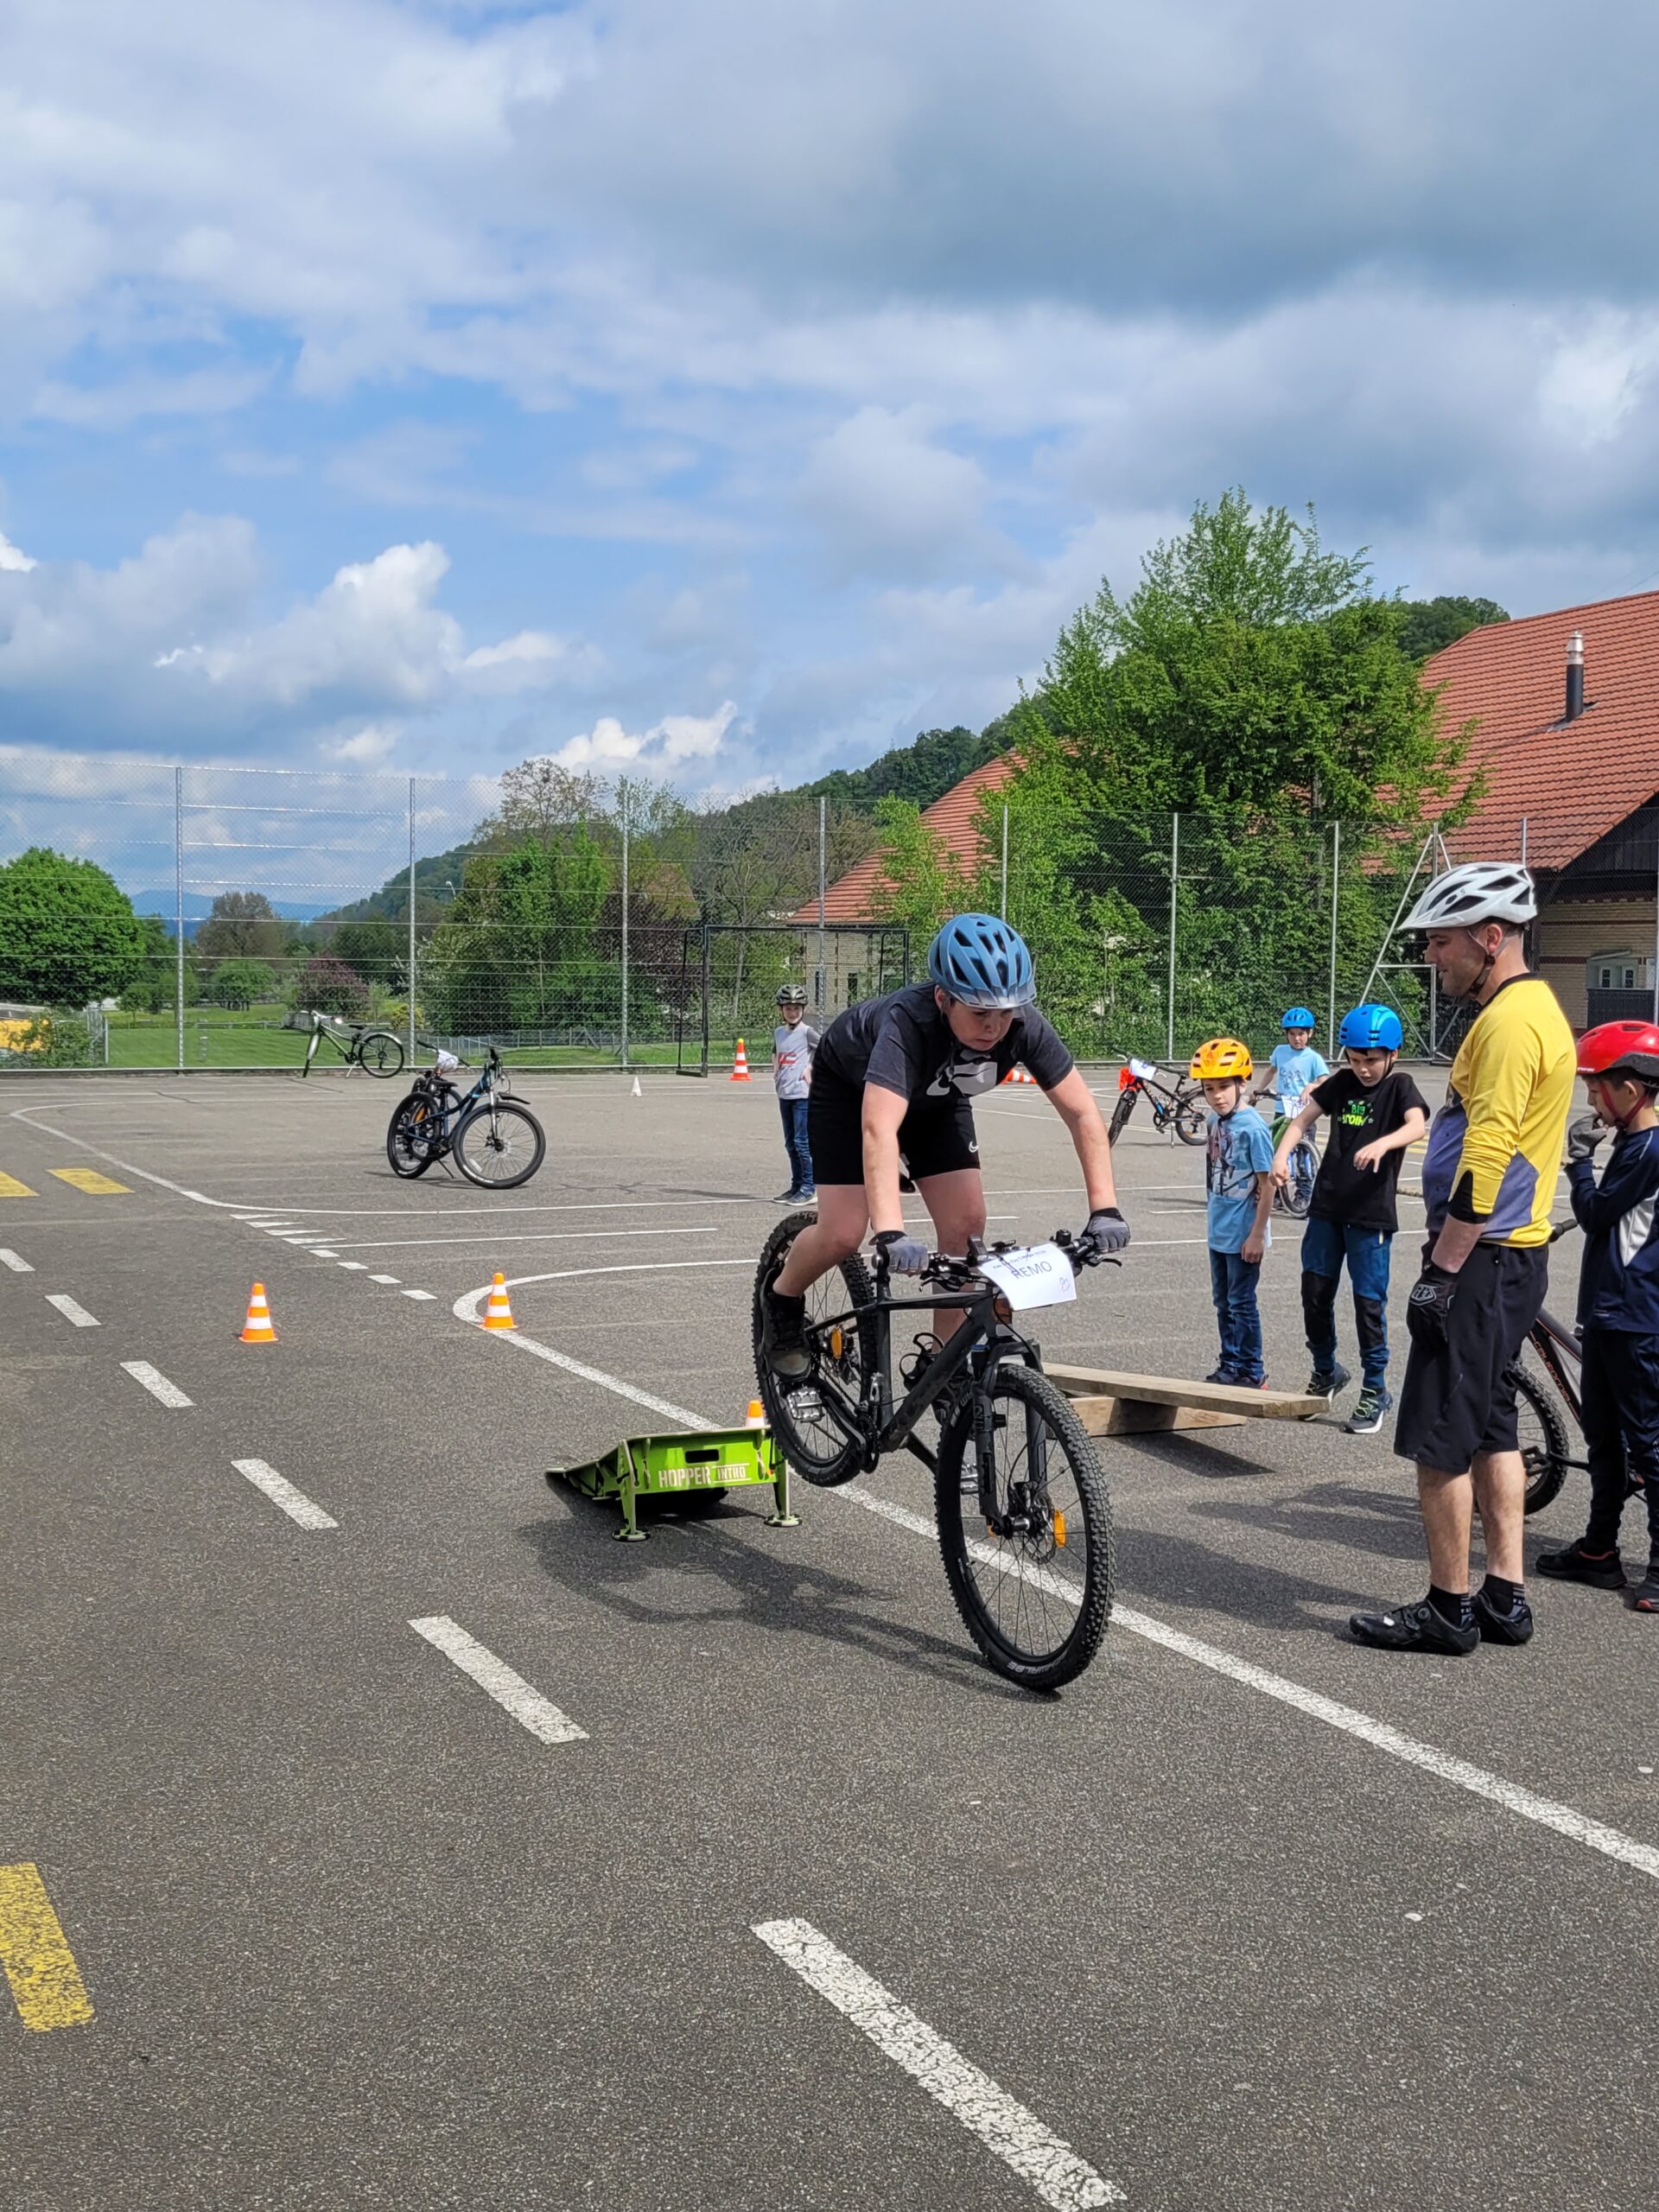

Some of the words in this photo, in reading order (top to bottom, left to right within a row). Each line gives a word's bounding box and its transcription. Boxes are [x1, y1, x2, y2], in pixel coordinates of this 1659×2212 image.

[1011, 1261, 1052, 1280] REMO
[658, 1466, 711, 1488] HOPPER
[717, 1466, 747, 1481] INTRO
